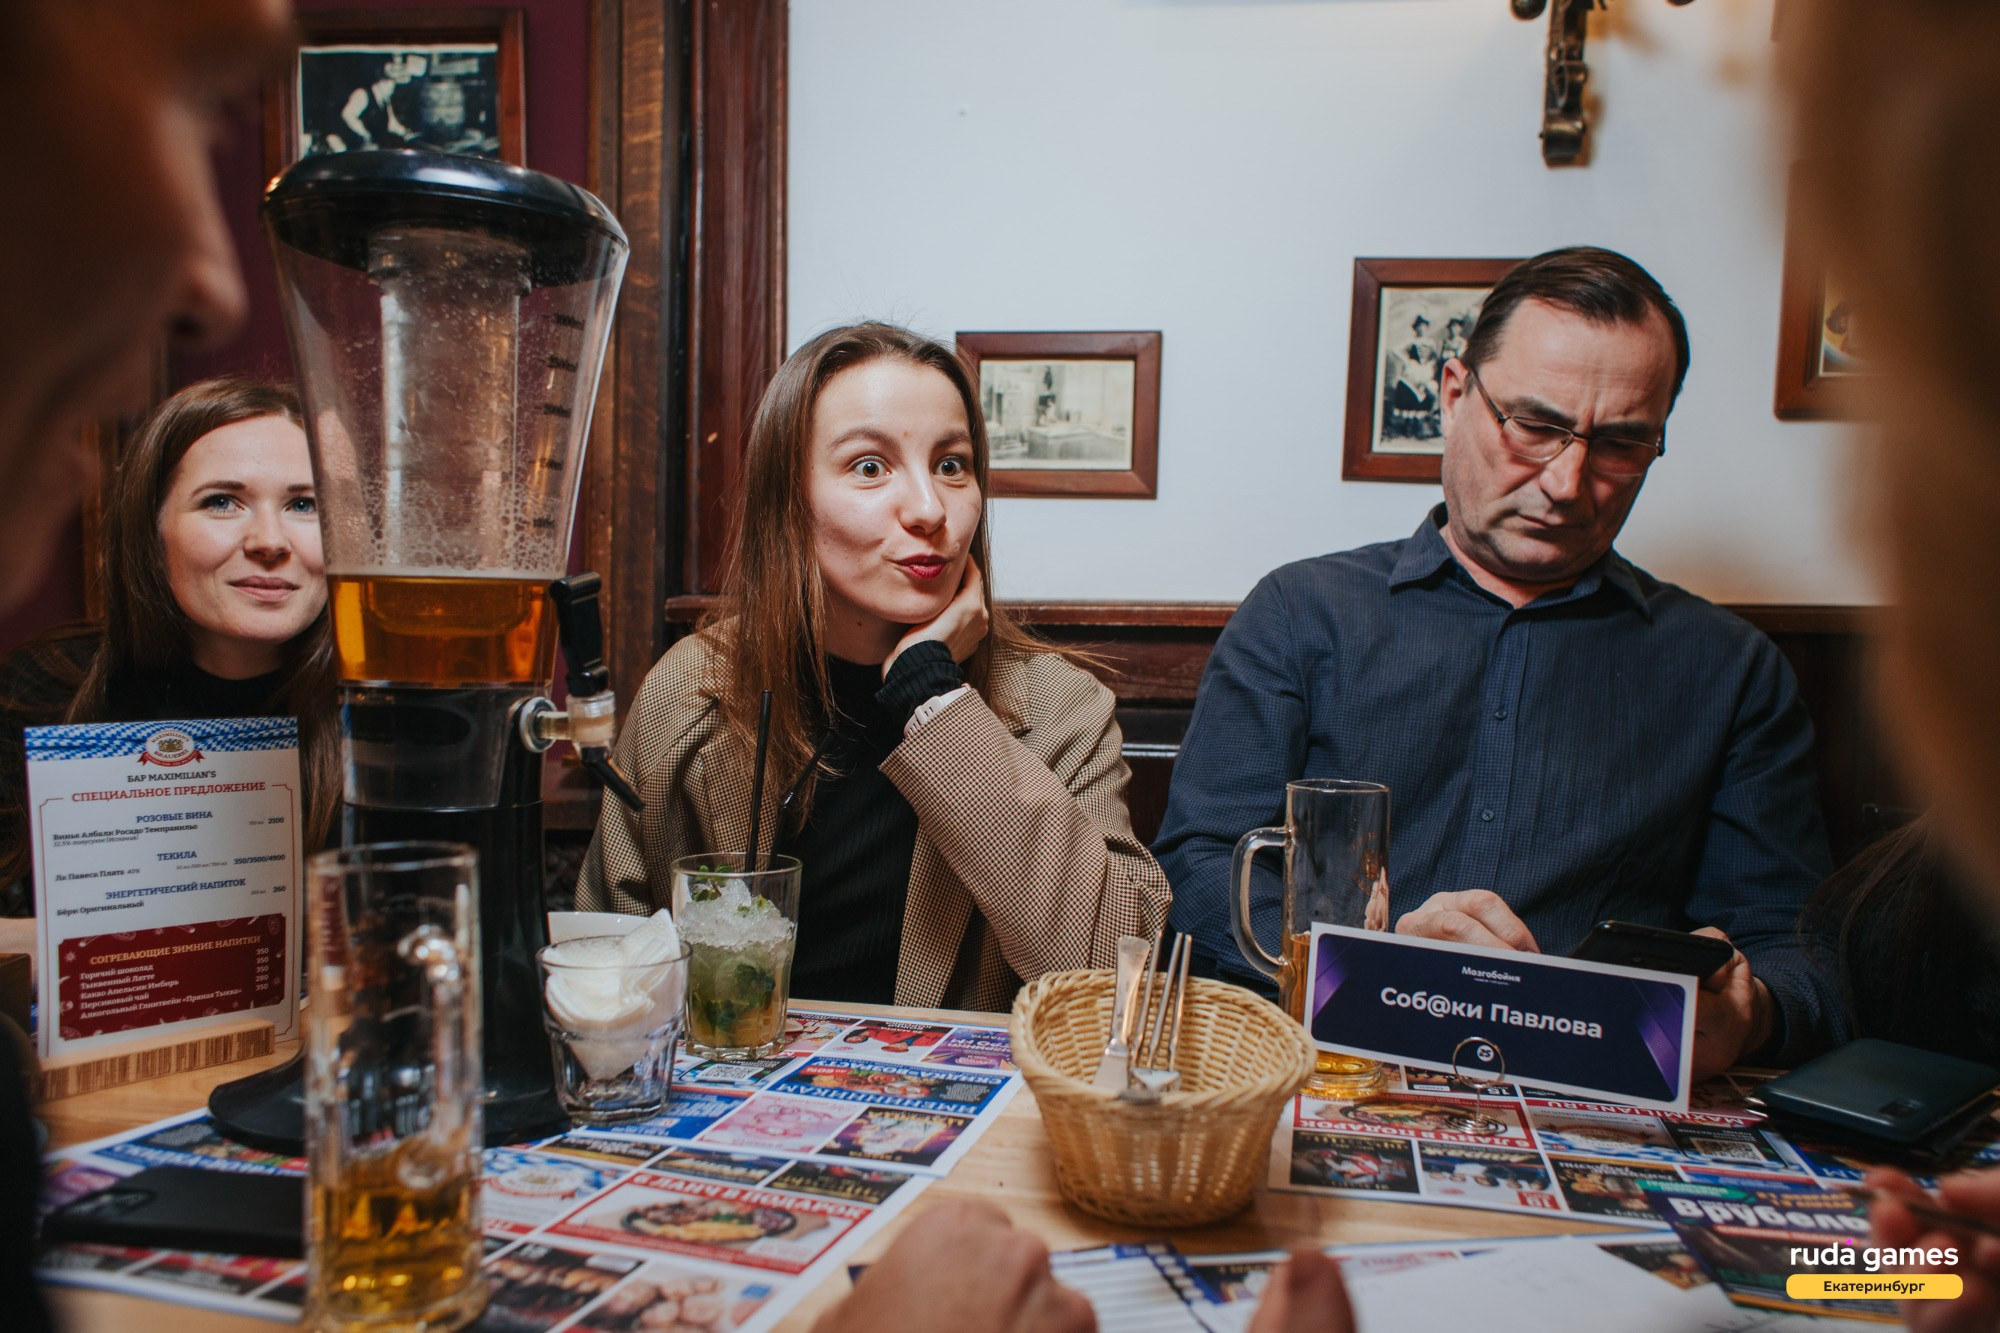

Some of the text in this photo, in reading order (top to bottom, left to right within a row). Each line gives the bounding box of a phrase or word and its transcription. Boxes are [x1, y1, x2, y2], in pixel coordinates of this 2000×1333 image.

[127, 770, 217, 783] БАР MAXIMILIAN'S
[71, 781, 266, 803] СПЕЦИАЛЬНОЕ ПРЕДЛОЖЕНИЕ
[136, 810, 213, 824] РОЗОВЫЕ ВИНА
[115, 827, 144, 836] Росадо
[144, 823, 198, 834] Темпранильо
[157, 850, 198, 861] ТЕКИЛА
[56, 873, 67, 882] Ла
[68, 871, 98, 880] Павеса
[99, 869, 125, 877] Плата
[105, 878, 247, 900] ЭНЕРГЕТИЧЕСКИЙ НАПИТОК
[80, 900, 145, 914] Оригинальный
[90, 935, 261, 966] СОГРЕВАЮЩИЕ ЗИМНИЕ НАПИТКИ
[256, 947, 269, 956] 350
[81, 964, 154, 980] Горячий шоколад
[1461, 965, 1521, 983] Мозгобойня
[81, 973, 156, 990] Тыквенный Латте
[81, 979, 180, 1000] Какао Апельсин Имбирь
[80, 1003, 138, 1020] Алкогольный
[138, 997, 182, 1011] Глинтвейн
[81, 991, 150, 1010] Персиковый чай
[1380, 986, 1603, 1040] Соб@ки Павлова
[1479, 1048, 1491, 1058] 25
[776, 1081, 978, 1116] ИМЕНИННИКАМ
[1300, 1118, 1412, 1138] ПОДАРОК
[650, 1176, 722, 1198] ЛАНЧ
[742, 1190, 864, 1220] ПОДАРОК
[1667, 1196, 1873, 1233] Врубель
